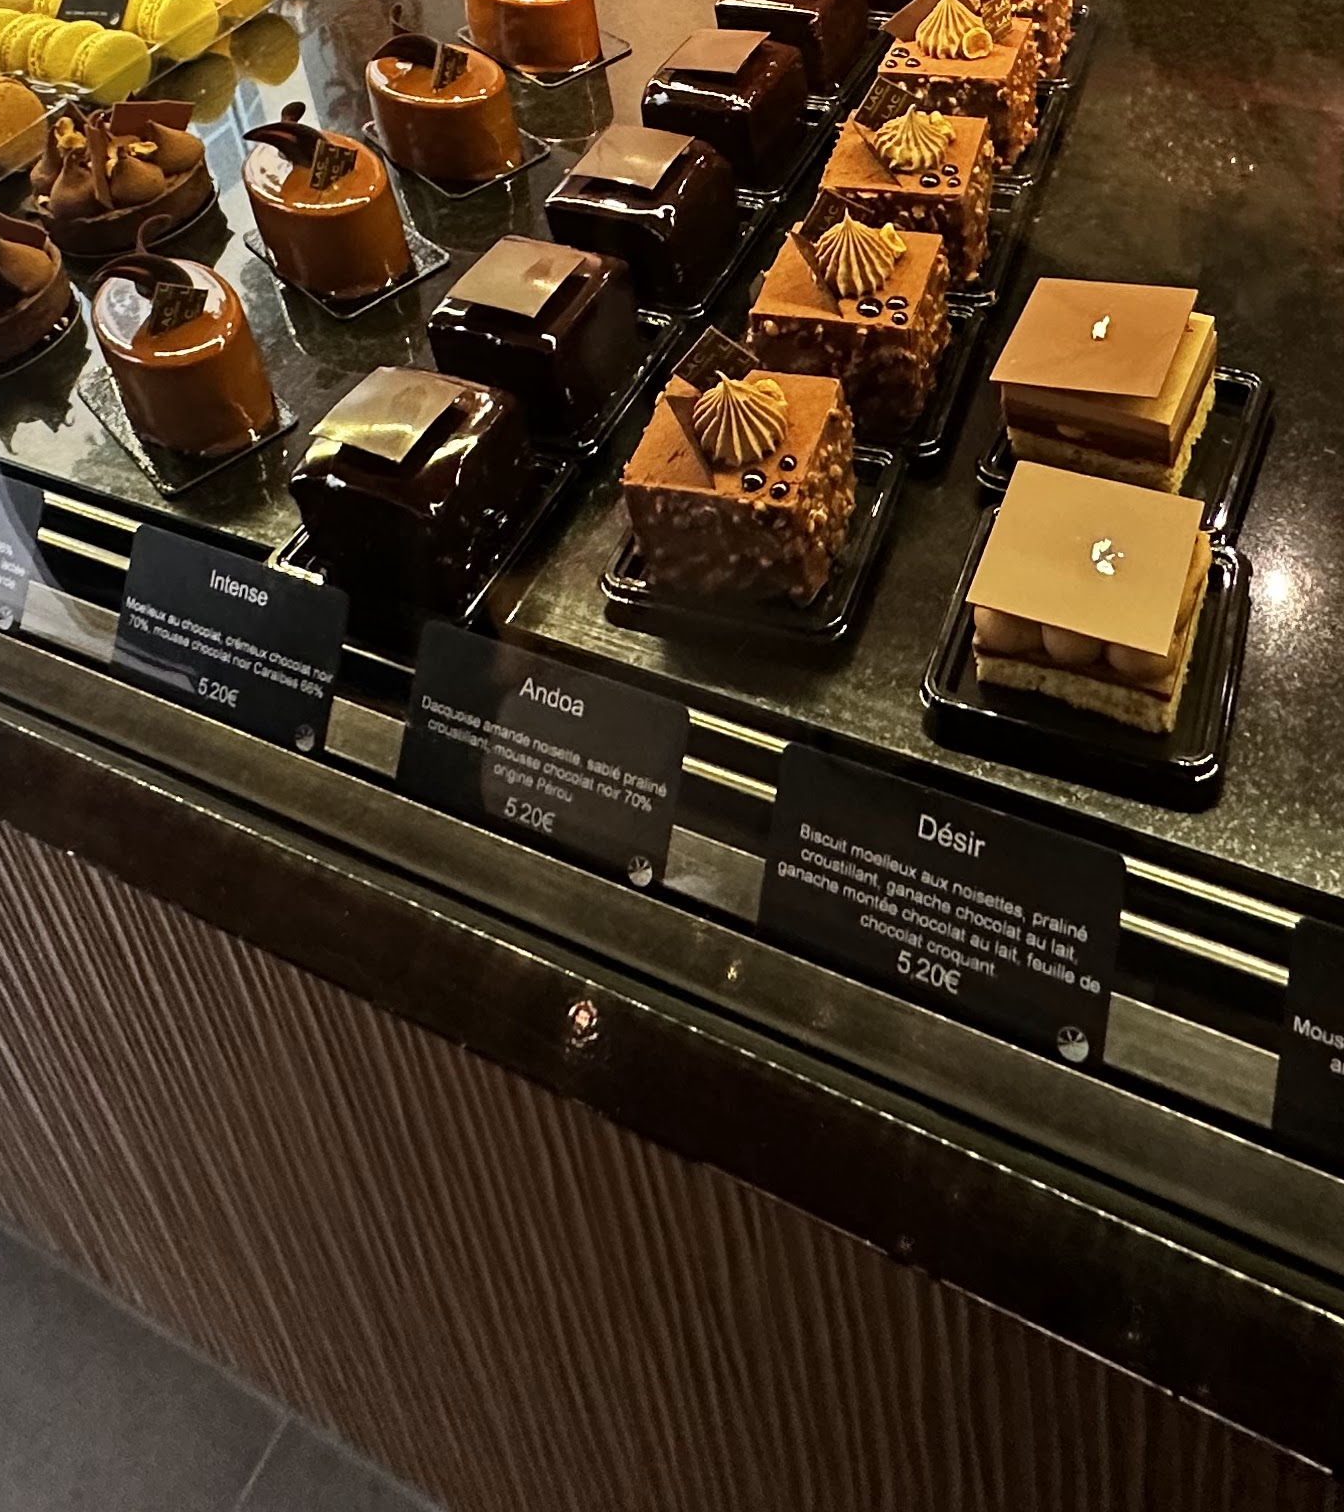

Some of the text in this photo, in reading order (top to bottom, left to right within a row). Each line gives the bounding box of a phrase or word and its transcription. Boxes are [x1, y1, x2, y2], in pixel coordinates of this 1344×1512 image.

[209, 569, 269, 607] Intense
[126, 596, 166, 621] Moelleux
[168, 615, 180, 626] au
[269, 653, 311, 676] chocolat
[313, 669, 333, 683] noir
[153, 626, 189, 647] mousse
[192, 641, 231, 663] chocolat
[232, 656, 252, 670] noir
[519, 677, 585, 717] Andoa
[422, 695, 481, 728] Dacquoise
[483, 721, 531, 747] amande
[587, 759, 620, 780] sablé
[623, 773, 666, 797] praliné
[493, 745, 540, 770] mousse
[543, 763, 594, 790] chocolat
[597, 783, 620, 799] noir
[625, 789, 652, 812] 70%
[494, 764, 572, 802] origine Pérou
[918, 813, 986, 858] Désir
[800, 823, 1087, 942] Biscuit moelleux aux noisettes, praliné
[778, 861, 839, 893] ganache
[843, 886, 898, 915] montée
[902, 909, 965, 942] chocolat
[970, 935, 990, 951] au
[1028, 953, 1075, 983] feuille
[1080, 976, 1100, 993] de
[860, 915, 922, 948] chocolat
[887, 881, 951, 914] ganache
[956, 907, 1021, 941] chocolat
[1026, 933, 1046, 950] au
